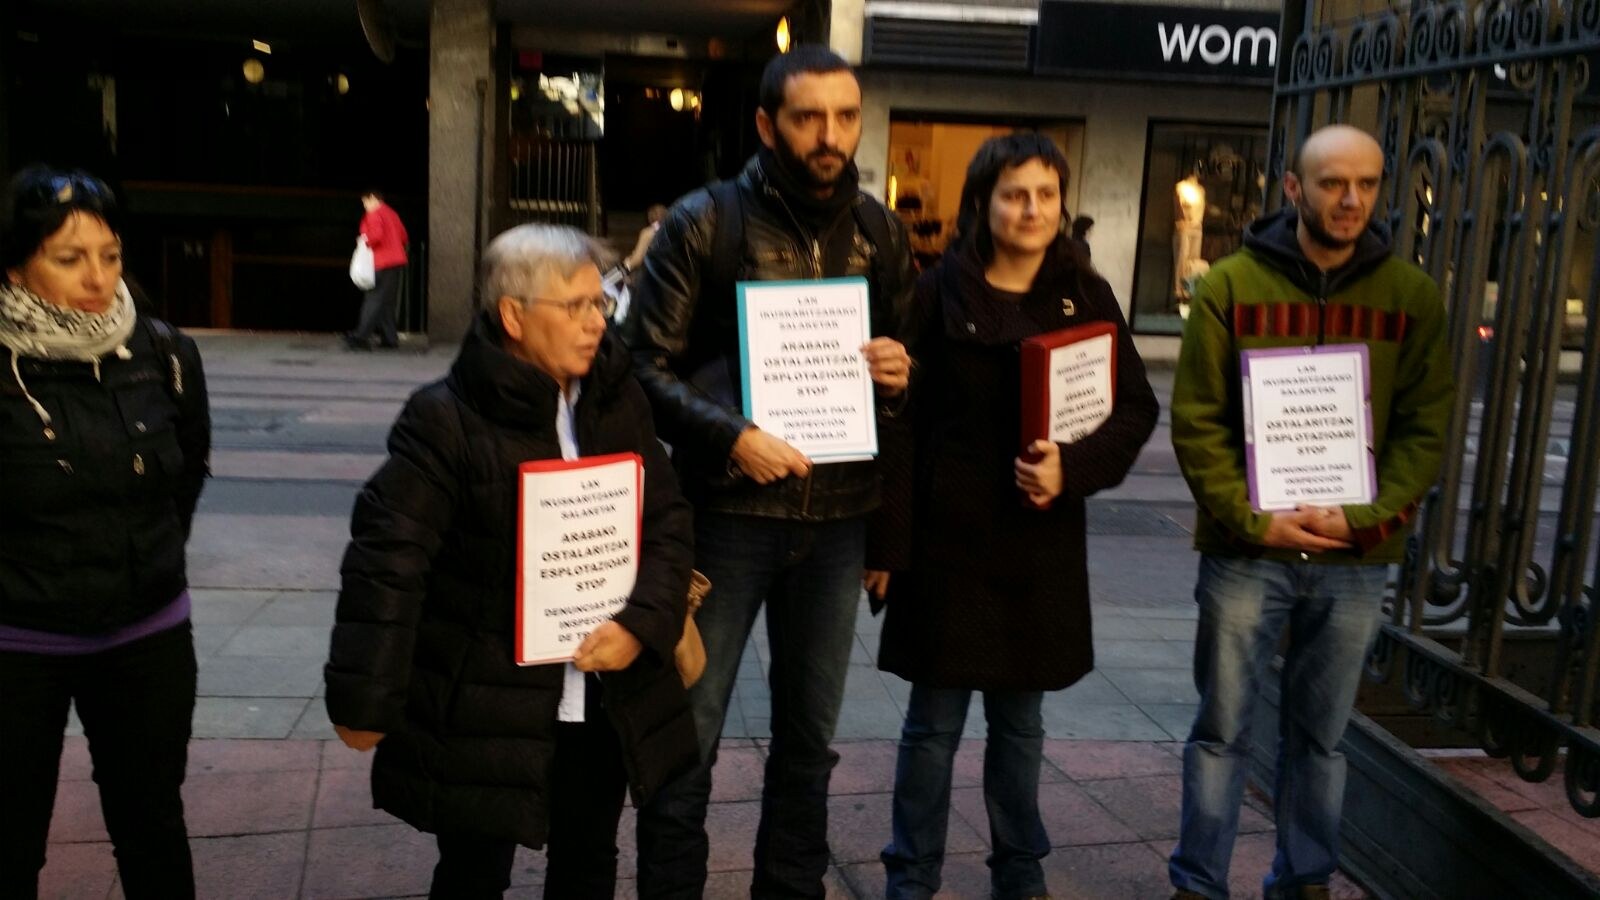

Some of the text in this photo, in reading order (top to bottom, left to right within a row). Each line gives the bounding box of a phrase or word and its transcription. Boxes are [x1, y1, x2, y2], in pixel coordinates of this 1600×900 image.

[1158, 22, 1277, 66] wom
[797, 385, 829, 397] STOP
[1297, 444, 1327, 456] STOP
[561, 525, 617, 543] ARABAKO
[575, 577, 607, 592] STOP
[558, 632, 572, 642] DE
